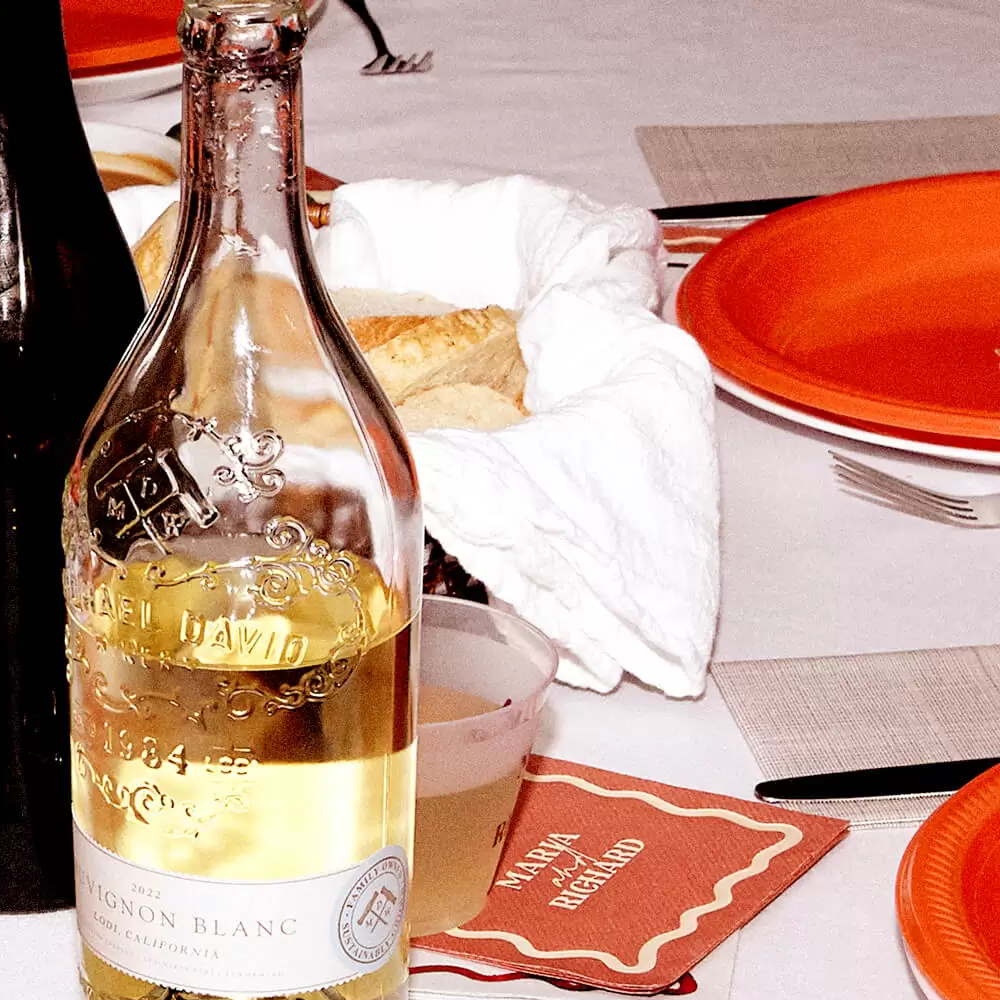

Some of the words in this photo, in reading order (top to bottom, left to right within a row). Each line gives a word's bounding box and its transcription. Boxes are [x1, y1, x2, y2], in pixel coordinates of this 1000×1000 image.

[179, 608, 309, 666] DAVID
[103, 721, 188, 776] 1984
[495, 832, 581, 891] MARIA
[546, 837, 600, 888] and
[548, 838, 645, 911] RICHARD
[131, 883, 162, 900] 2022
[125, 929, 220, 960] CALIFORNIA
[192, 916, 298, 938] BLANC
